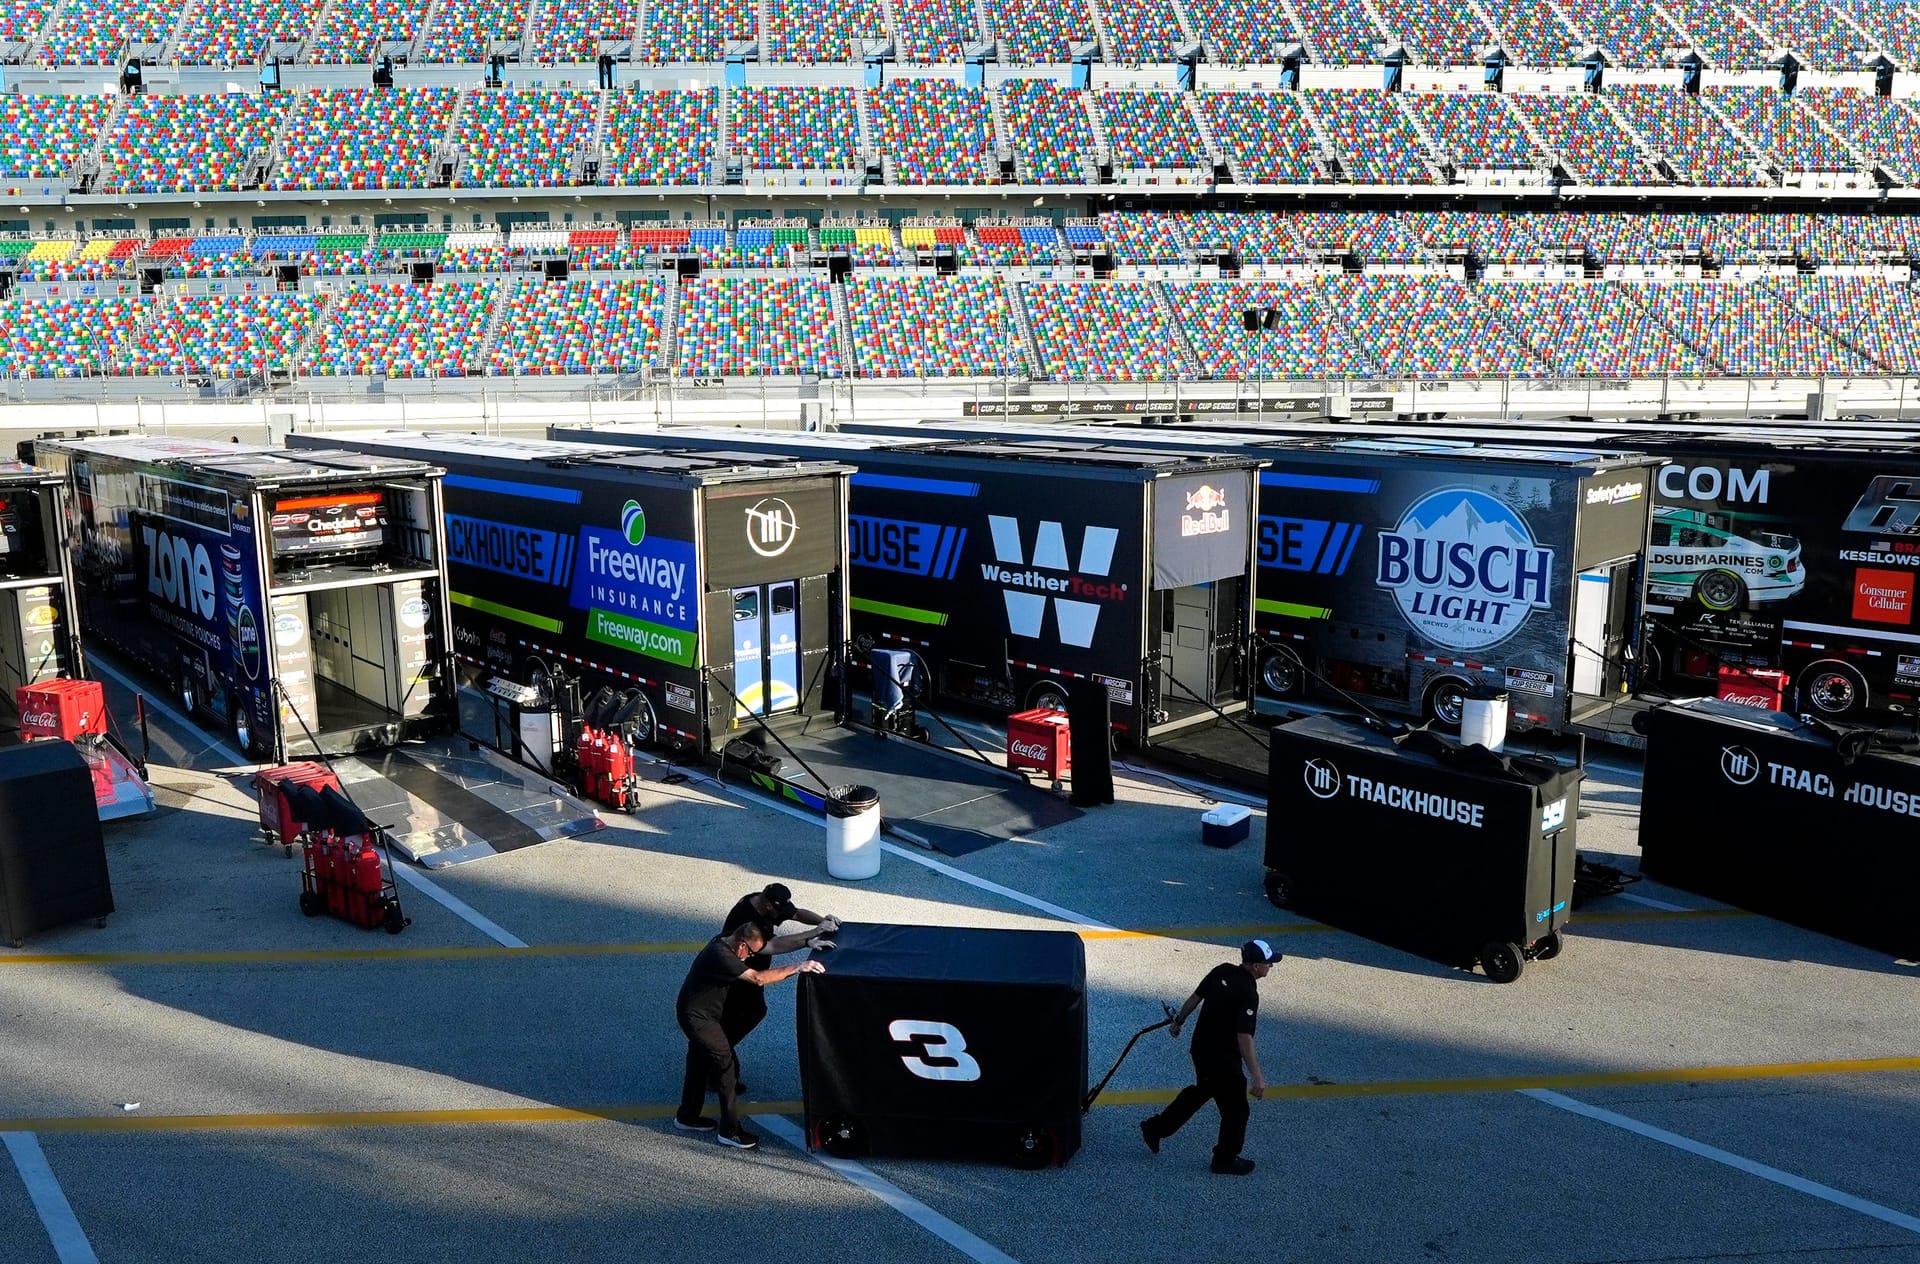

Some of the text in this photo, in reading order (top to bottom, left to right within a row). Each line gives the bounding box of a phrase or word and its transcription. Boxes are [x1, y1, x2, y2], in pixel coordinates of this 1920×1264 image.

[1149, 402, 1174, 411] SERIES
[1197, 402, 1237, 410] CUP SERIES
[1362, 401, 1387, 409] SERIES
[1658, 464, 1770, 504] COM
[307, 516, 362, 533] Cheddar's
[1182, 509, 1230, 536] Red Bull
[309, 530, 368, 544] CHEVROLET
[1257, 520, 1304, 567] SE
[588, 535, 686, 601] Freeway
[1839, 549, 1920, 566] KESELOWS
[142, 524, 216, 621] zone
[1378, 534, 1551, 603] BUSCH
[1859, 582, 1908, 599] Consumer
[590, 584, 686, 621] INSURANCE
[1410, 591, 1511, 625] LIGHT
[1868, 595, 1908, 611] Cellular
[597, 612, 683, 656] Freeway.com
[1422, 619, 1449, 628] BREWED
[1743, 619, 1775, 629] ALLIANCE
[195, 624, 221, 650] POUCHES
[1511, 679, 1548, 691] CUP SERIES
[1520, 671, 1548, 682] NASCAR
[1346, 774, 1485, 828] TRACKHOUSE
[888, 1019, 982, 1083] 3
